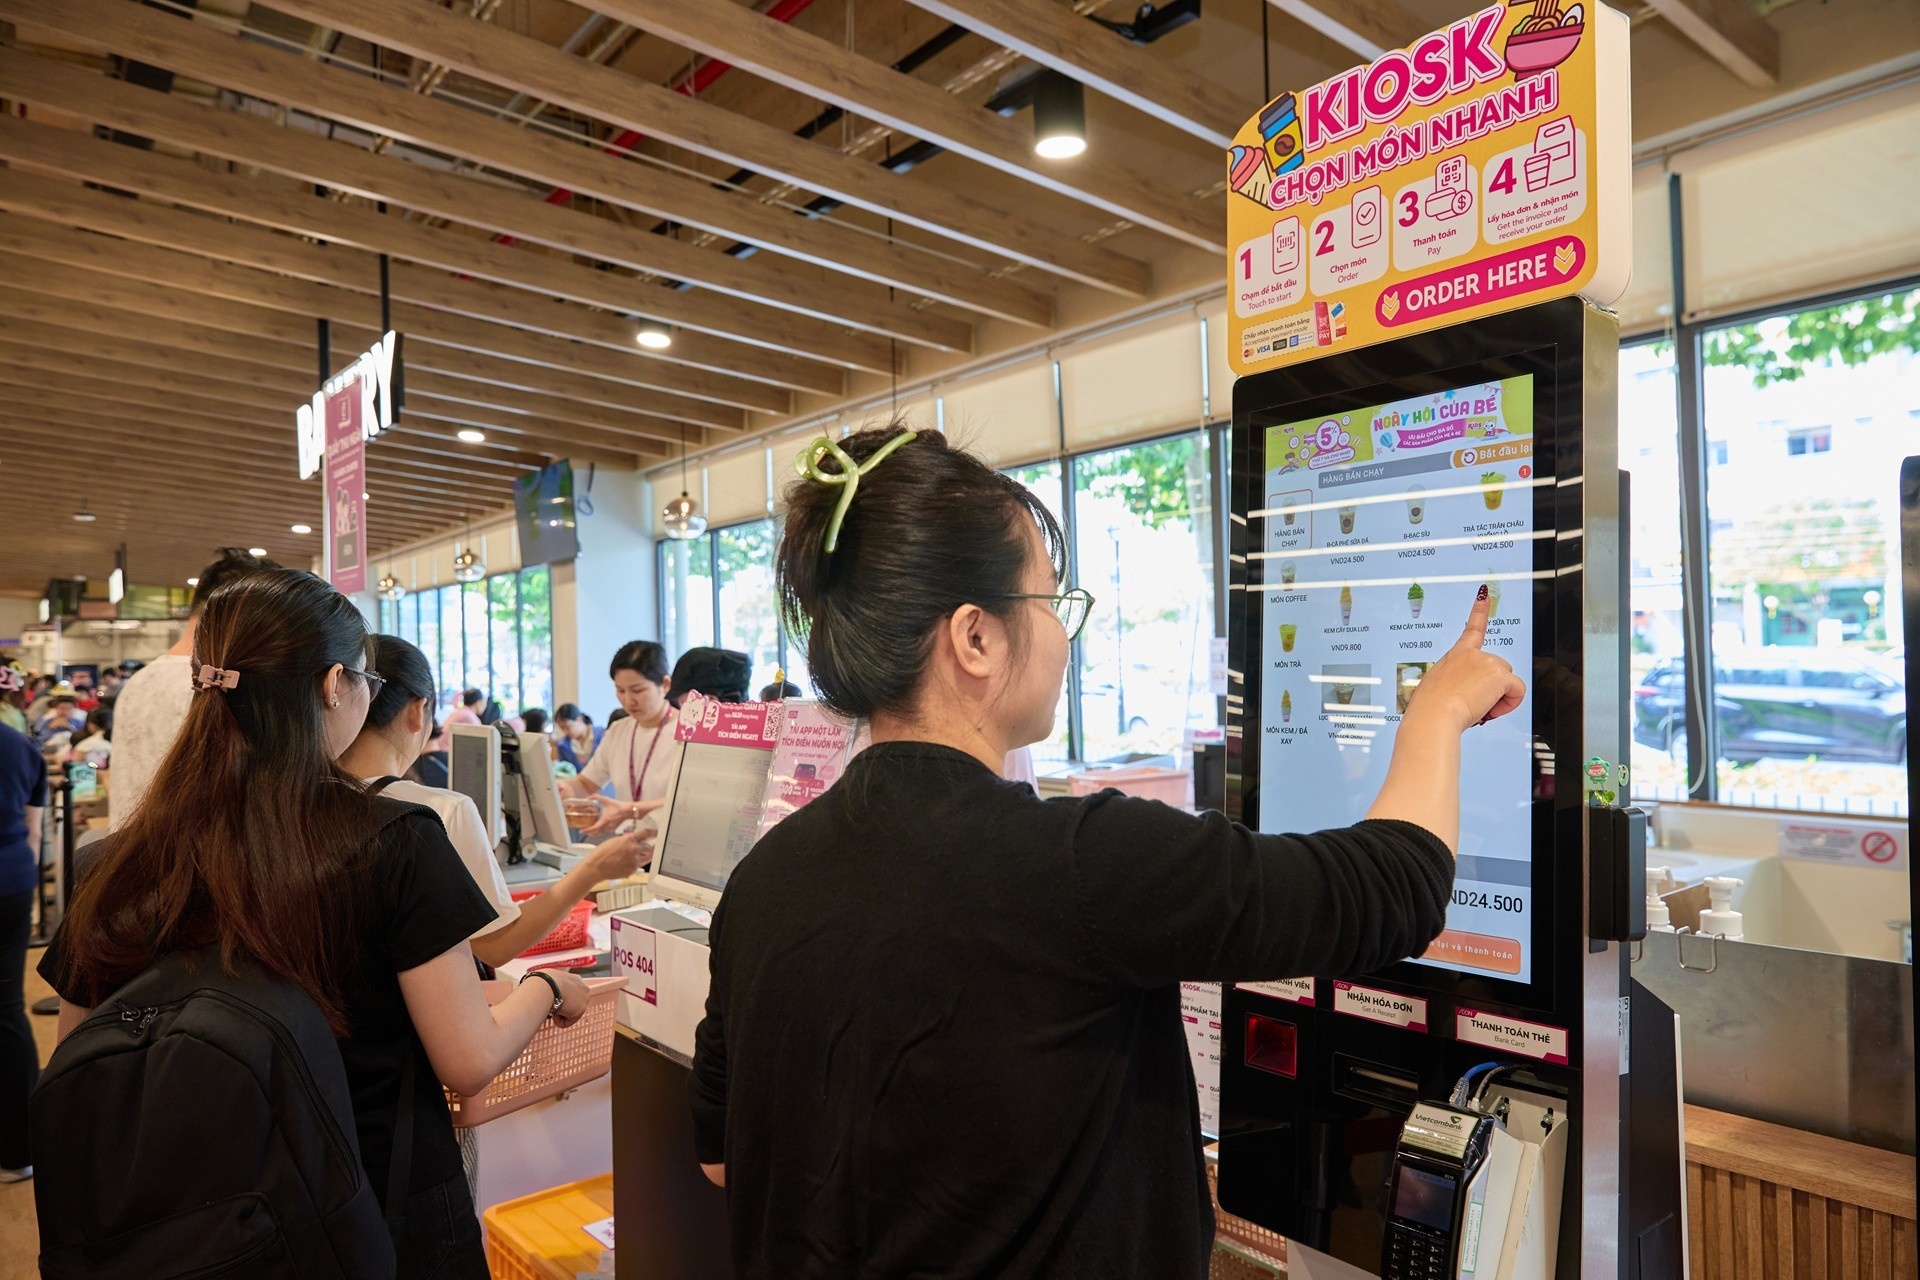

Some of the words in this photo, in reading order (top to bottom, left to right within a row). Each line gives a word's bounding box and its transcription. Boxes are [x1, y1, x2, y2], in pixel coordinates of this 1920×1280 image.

[1307, 9, 1499, 147] KIOSK
[1270, 154, 1345, 201] CHỌN
[1354, 126, 1421, 173] MÓN
[1432, 75, 1552, 148] NHANH
[1488, 156, 1517, 195] 4
[1398, 190, 1420, 228] 3
[1487, 212, 1500, 225] Lấy
[1501, 209, 1515, 220] hóa
[1516, 204, 1532, 215] đơn
[1533, 201, 1539, 211] &
[1540, 196, 1560, 209] nhận
[1561, 189, 1579, 202] món
[1496, 220, 1510, 231] Get
[1512, 217, 1524, 227] the
[1525, 209, 1552, 223] invoice
[1553, 204, 1568, 215] and
[1499, 227, 1525, 240] receive
[1526, 222, 1543, 236] your
[1544, 214, 1567, 227] order
[1315, 220, 1335, 256] 2
[1412, 233, 1437, 248] Thanh
[1438, 227, 1457, 242] toán
[1427, 245, 1441, 256] Pay
[1240, 248, 1251, 280] 1
[1330, 262, 1349, 275] Chọn
[1350, 256, 1367, 268] món
[1337, 271, 1359, 284] Order
[1406, 272, 1480, 312] ORDER
[1487, 253, 1548, 291] HERE
[1241, 288, 1260, 302] Chạm
[1260, 284, 1270, 295] để
[1283, 278, 1297, 290] đầu
[1248, 300, 1267, 311] Touch
[1268, 297, 1275, 305] to
[1276, 291, 1292, 303] start
[1319, 332, 1331, 340] PAY
[1256, 344, 1271, 354] VISA
[296, 330, 396, 481] BARY
[1373, 411, 1410, 432] NGÀY
[1412, 406, 1436, 425] HỘI
[1439, 399, 1470, 420] CỦA
[1473, 394, 1498, 415] BÉ
[1480, 448, 1496, 459] Bắt
[1499, 443, 1517, 456] đầu
[1322, 472, 1344, 484] HÀNG
[1345, 470, 1361, 481] BÁN
[1363, 467, 1385, 478] CHẠY
[1274, 528, 1292, 538] HÀNG
[1292, 526, 1305, 536] BÁN
[1463, 525, 1476, 533] TRÀ
[1397, 547, 1436, 558] VND24.500
[1472, 540, 1514, 551] VND24.500
[1330, 555, 1365, 565] VND24.500
[1270, 595, 1285, 604] MÓN
[1285, 594, 1308, 603] COFFEE
[1389, 623, 1402, 631] KEM
[1414, 622, 1426, 630] TRÀ
[1426, 622, 1443, 630] XANH
[1331, 643, 1362, 651] VND9.800
[1398, 640, 1433, 649] VND9.800
[1274, 659, 1289, 668] MÓN
[1290, 659, 1302, 668] TRÀ
[711, 705, 717, 718] 2
[800, 726, 812, 735] APP
[1266, 726, 1280, 735] MÓN
[1280, 727, 1294, 735] KEM
[1449, 889, 1523, 913] ND24.500
[1437, 941, 1448, 950] lại
[1451, 943, 1462, 951] và
[1464, 946, 1489, 956] thanh
[1492, 950, 1513, 960] toán
[613, 946, 634, 968] POS
[635, 955, 654, 976] 404
[1182, 982, 1201, 992] KIOSK
[1267, 984, 1293, 995] Membership
[1294, 980, 1310, 990] VIÊN
[1346, 991, 1371, 1005] NHẬN
[1372, 995, 1392, 1009] HÓA
[1392, 1000, 1413, 1013] ĐƠN
[1361, 1005, 1371, 1013] Get
[1377, 1008, 1397, 1019] Receipt
[1470, 1019, 1502, 1033] THANH
[1504, 1026, 1530, 1039] TOÁN
[1531, 1032, 1551, 1044] THẺ
[1494, 1035, 1509, 1044] Bank
[1510, 1039, 1525, 1048] Card
[1415, 1113, 1463, 1131] Vietcombank
